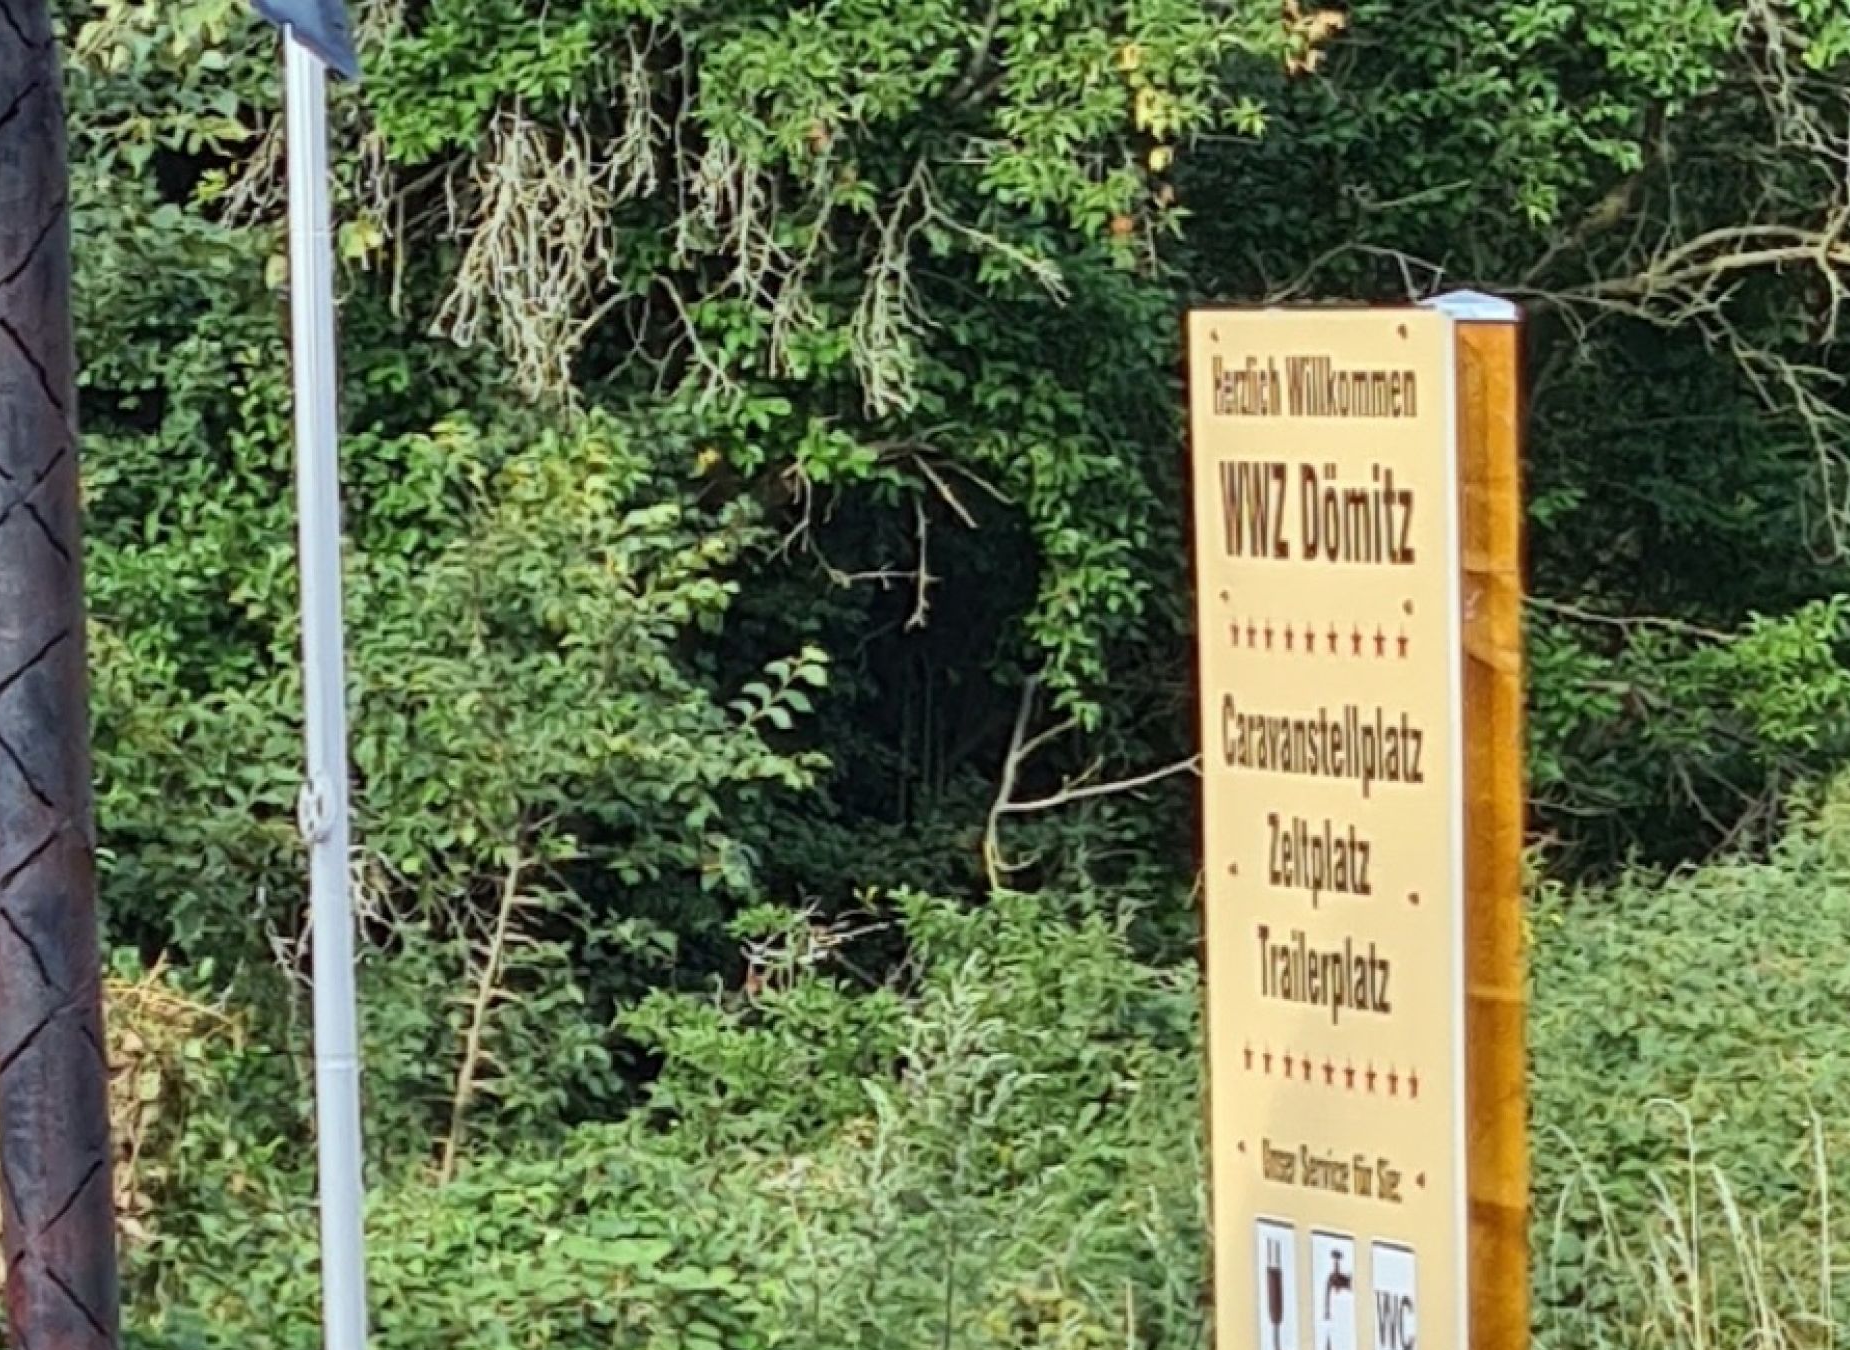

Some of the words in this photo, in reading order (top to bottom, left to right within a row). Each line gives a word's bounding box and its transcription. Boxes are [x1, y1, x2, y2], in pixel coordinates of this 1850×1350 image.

[1285, 356, 1418, 418] Willkommen
[1219, 460, 1290, 560] WWZ
[1299, 462, 1415, 565] Dömitz
[1221, 693, 1423, 799] Caravanstellplatz
[1267, 812, 1372, 910] Zeltplatz
[1257, 924, 1391, 1026] Trailerplatz
